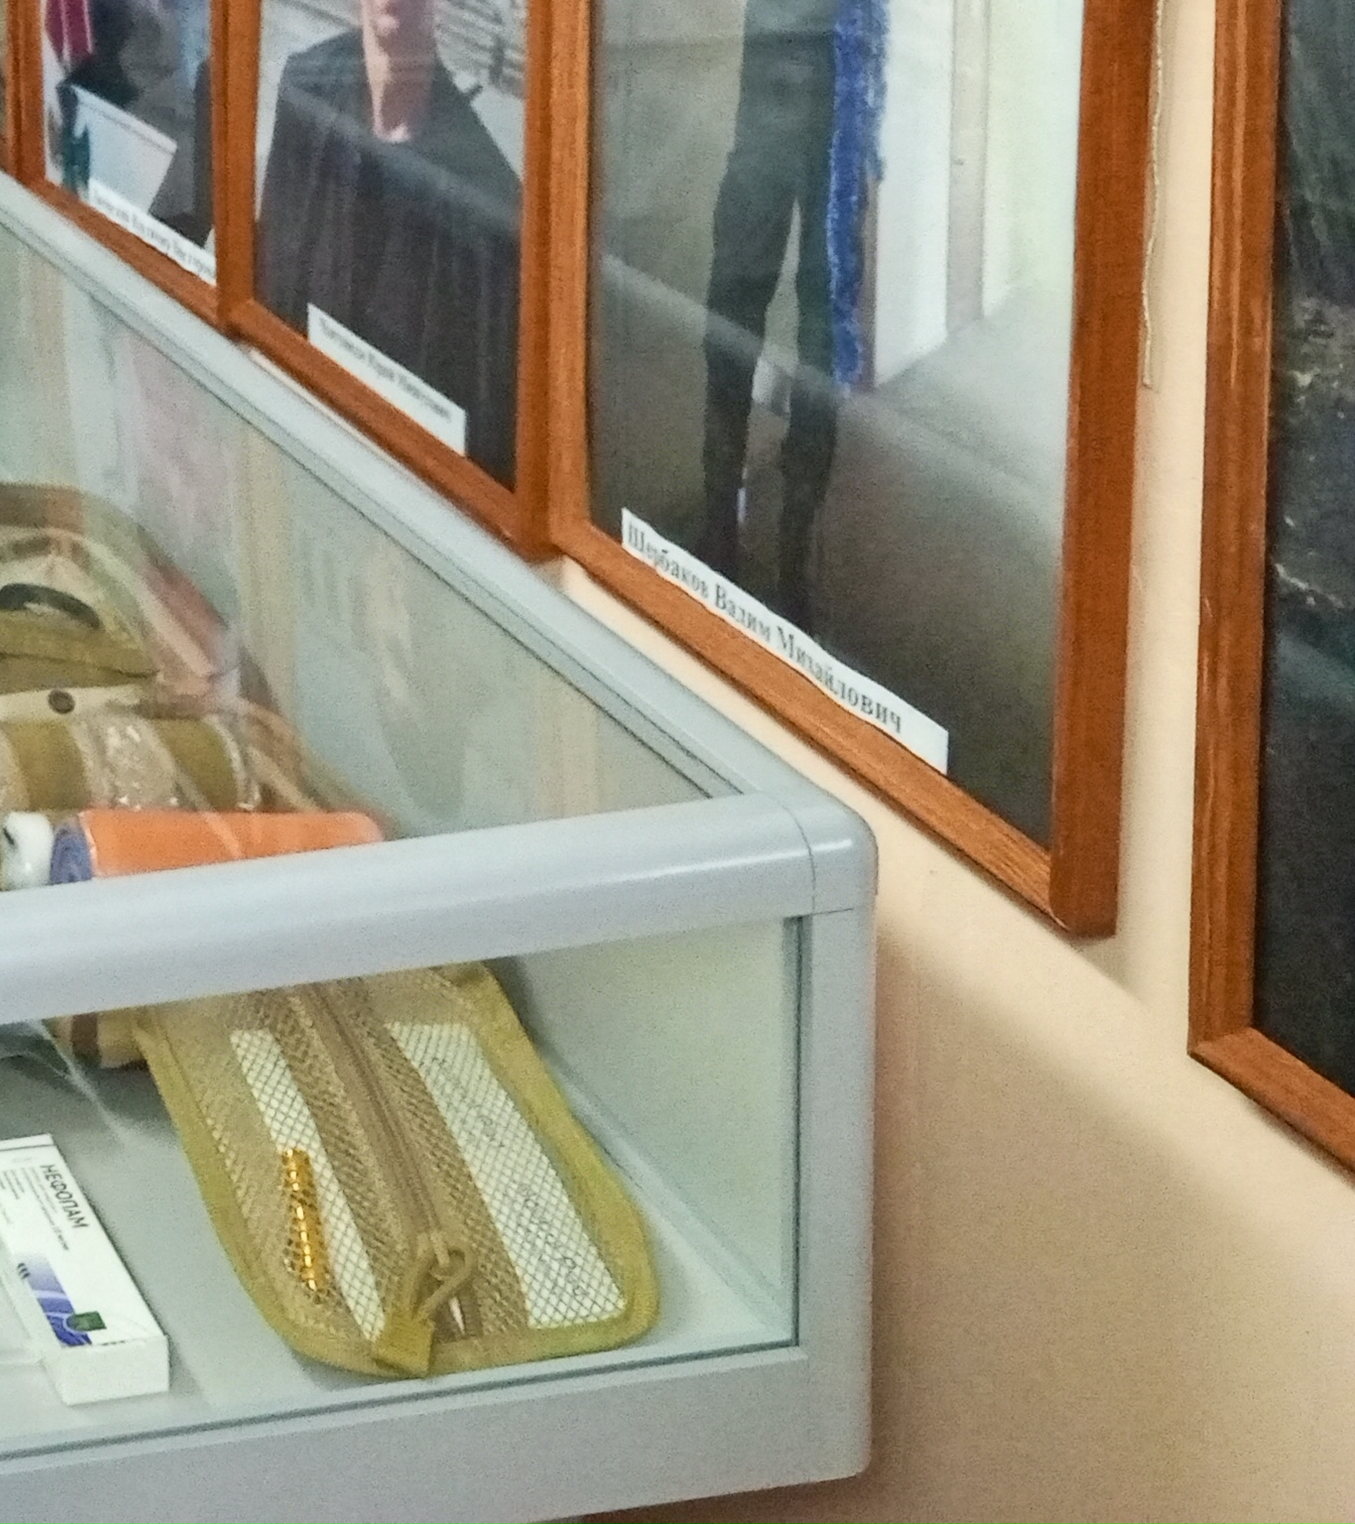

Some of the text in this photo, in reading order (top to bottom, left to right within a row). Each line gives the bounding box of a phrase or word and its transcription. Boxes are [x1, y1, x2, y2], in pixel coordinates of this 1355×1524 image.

[714, 582, 772, 643] Вадим
[776, 625, 902, 733] Михайлович
[39, 1164, 89, 1228] НЕФОПАМ
